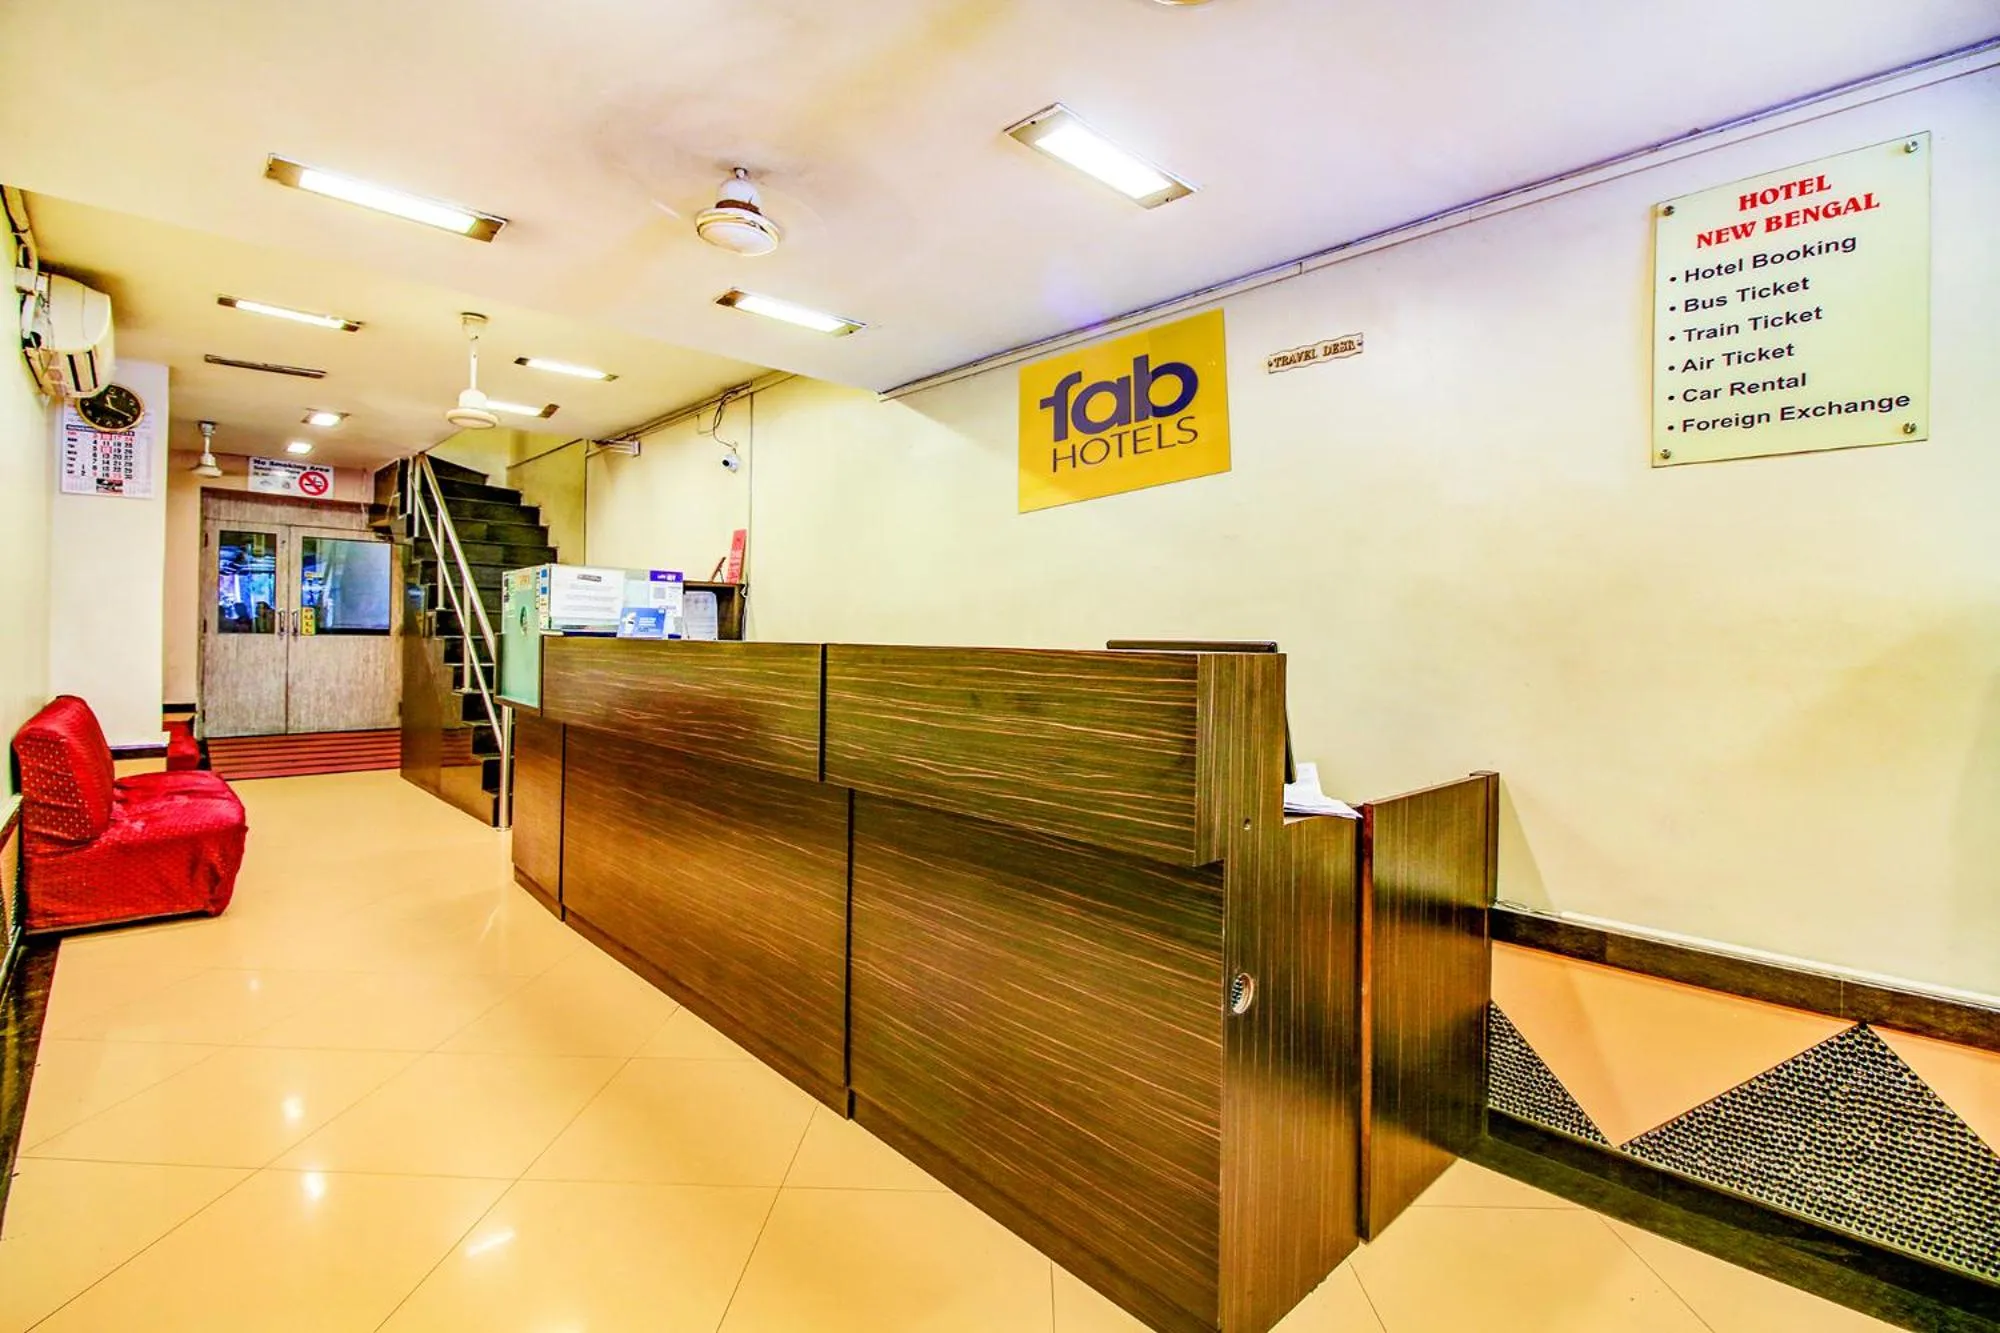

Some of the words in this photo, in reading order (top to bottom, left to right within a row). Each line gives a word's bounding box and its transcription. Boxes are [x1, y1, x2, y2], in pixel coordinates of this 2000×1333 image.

[1738, 173, 1832, 212] HOTEL
[1696, 220, 1756, 249] NEW
[1764, 192, 1880, 233] BENGAL
[1684, 258, 1743, 283] Hotel
[1752, 236, 1857, 269] Booking
[1684, 294, 1728, 313] Bus
[1737, 276, 1810, 303] Ticket
[1683, 322, 1739, 343] Train
[1748, 306, 1823, 331] Ticket
[1681, 355, 1714, 373] Air
[1722, 343, 1795, 367] Ticket
[1039, 354, 1199, 443] fab
[1682, 386, 1722, 403] Car
[1730, 372, 1807, 397] Rental
[1682, 409, 1770, 433] Foreign
[1780, 394, 1911, 422] Exchange
[1052, 415, 1198, 473] HOTELS
